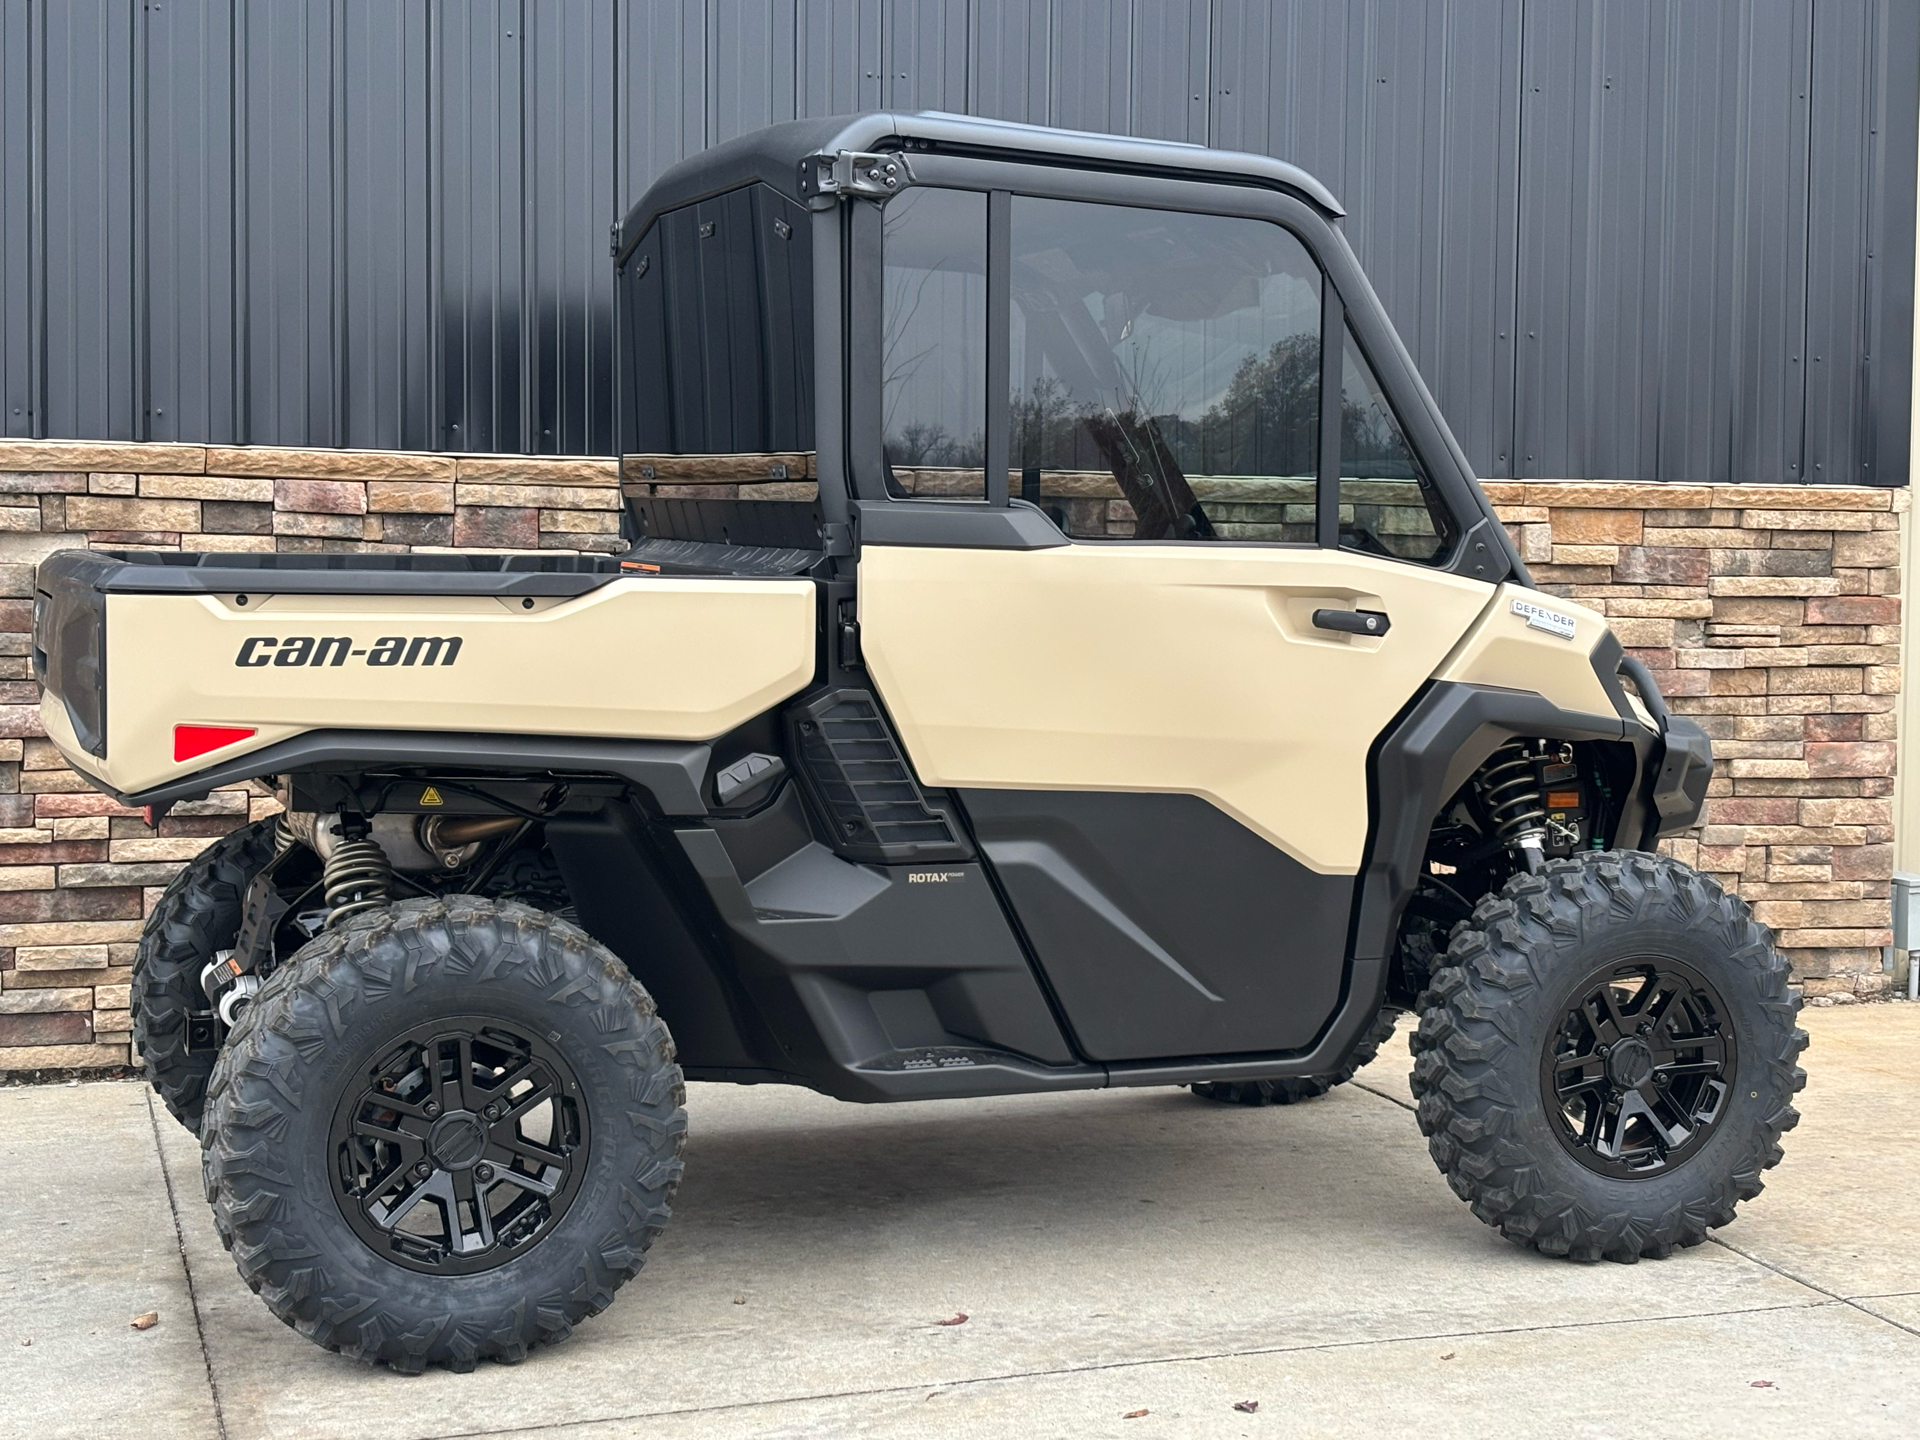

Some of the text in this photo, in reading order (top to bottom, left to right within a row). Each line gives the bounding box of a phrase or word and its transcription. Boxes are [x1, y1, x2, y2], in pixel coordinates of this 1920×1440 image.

[1515, 602, 1575, 627] DEFENDER
[235, 636, 464, 667] can-am
[908, 872, 948, 883] ROTAX
[580, 1116, 617, 1223] FORCE
